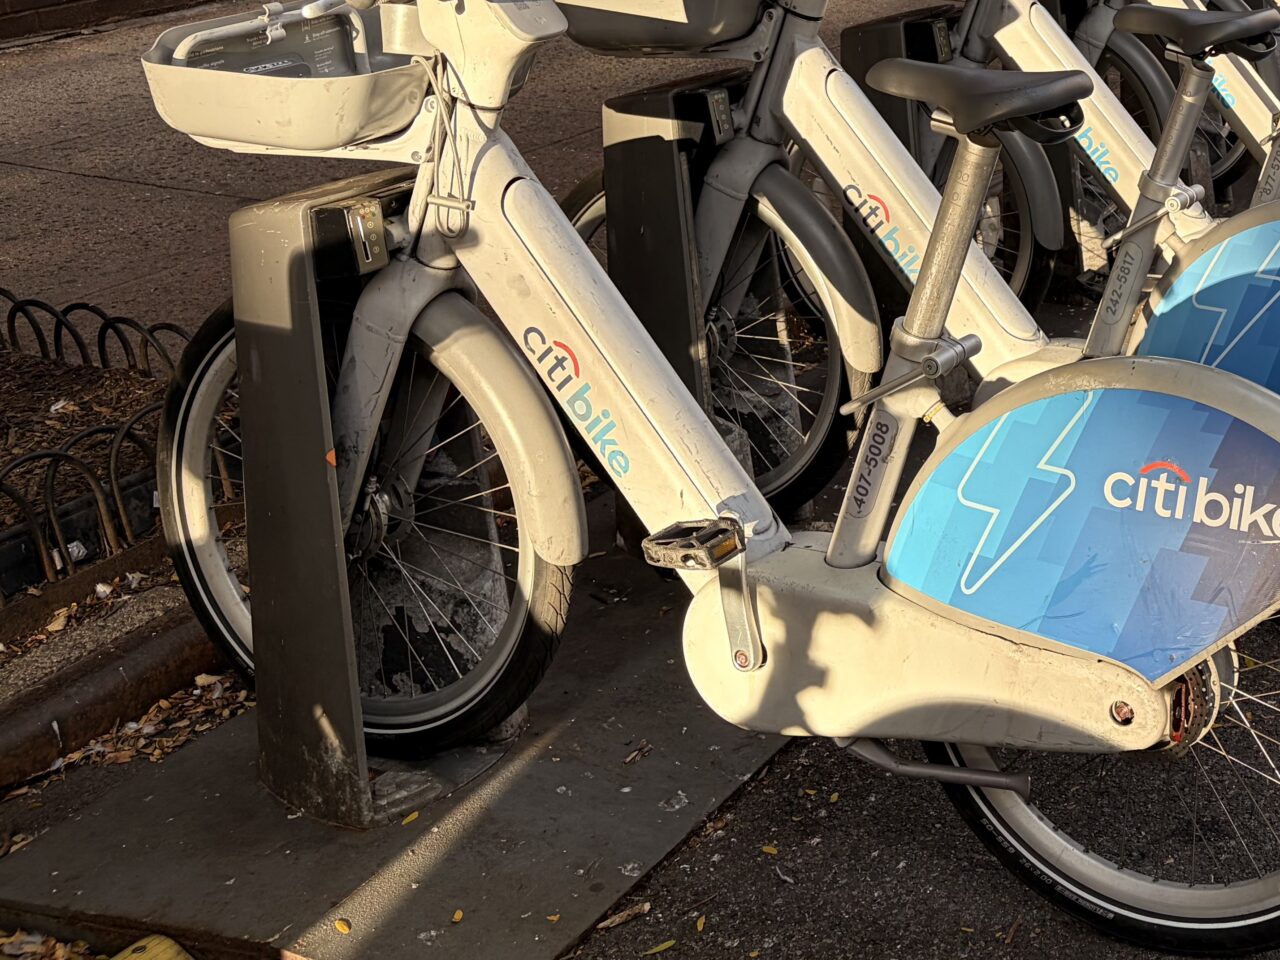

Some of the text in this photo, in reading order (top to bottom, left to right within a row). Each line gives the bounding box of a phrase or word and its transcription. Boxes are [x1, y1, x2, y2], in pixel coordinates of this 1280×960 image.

[843, 184, 885, 235] citi
[1106, 251, 1136, 316] 242-5817
[523, 326, 630, 478] citi bike
[852, 421, 890, 506] 407-5008
[1103, 468, 1189, 520] citi
